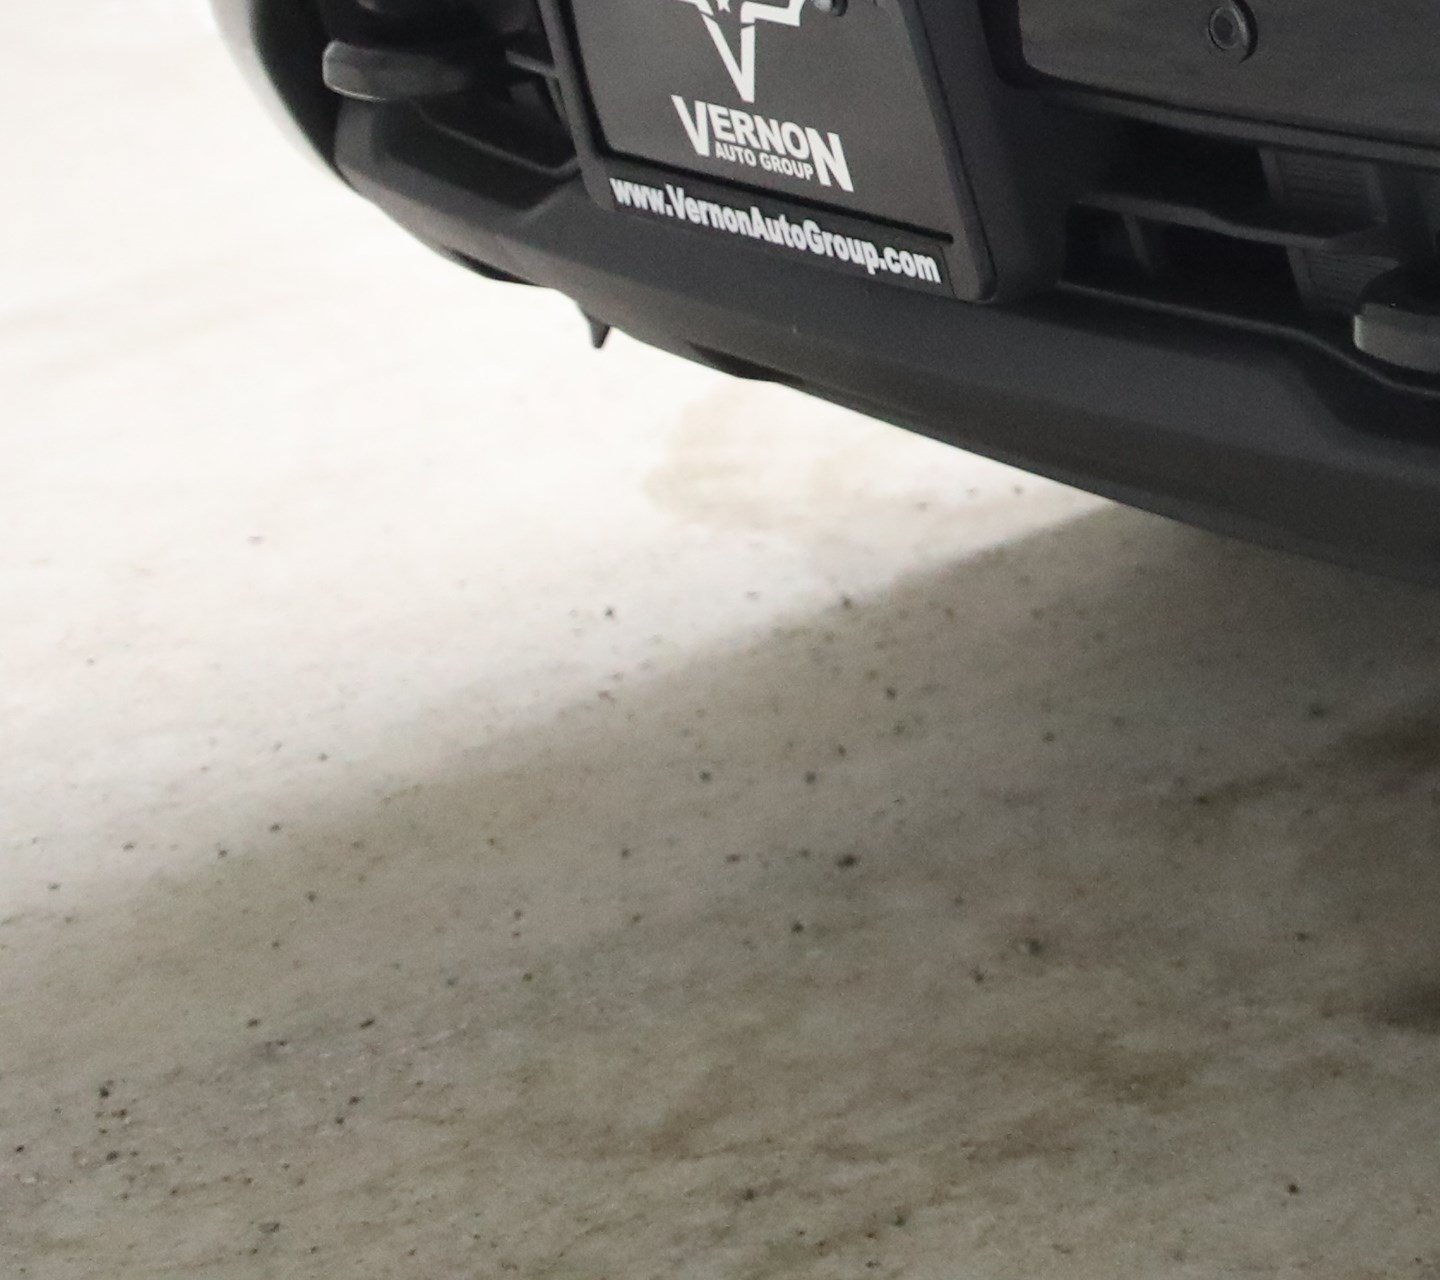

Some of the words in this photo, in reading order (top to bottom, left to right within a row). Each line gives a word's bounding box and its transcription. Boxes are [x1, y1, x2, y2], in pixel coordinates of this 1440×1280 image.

[670, 94, 855, 193] VERNON
[714, 144, 757, 168] AUTO
[760, 157, 815, 181] GROUP
[609, 177, 942, 284] www.VernonAutoGroup.com
